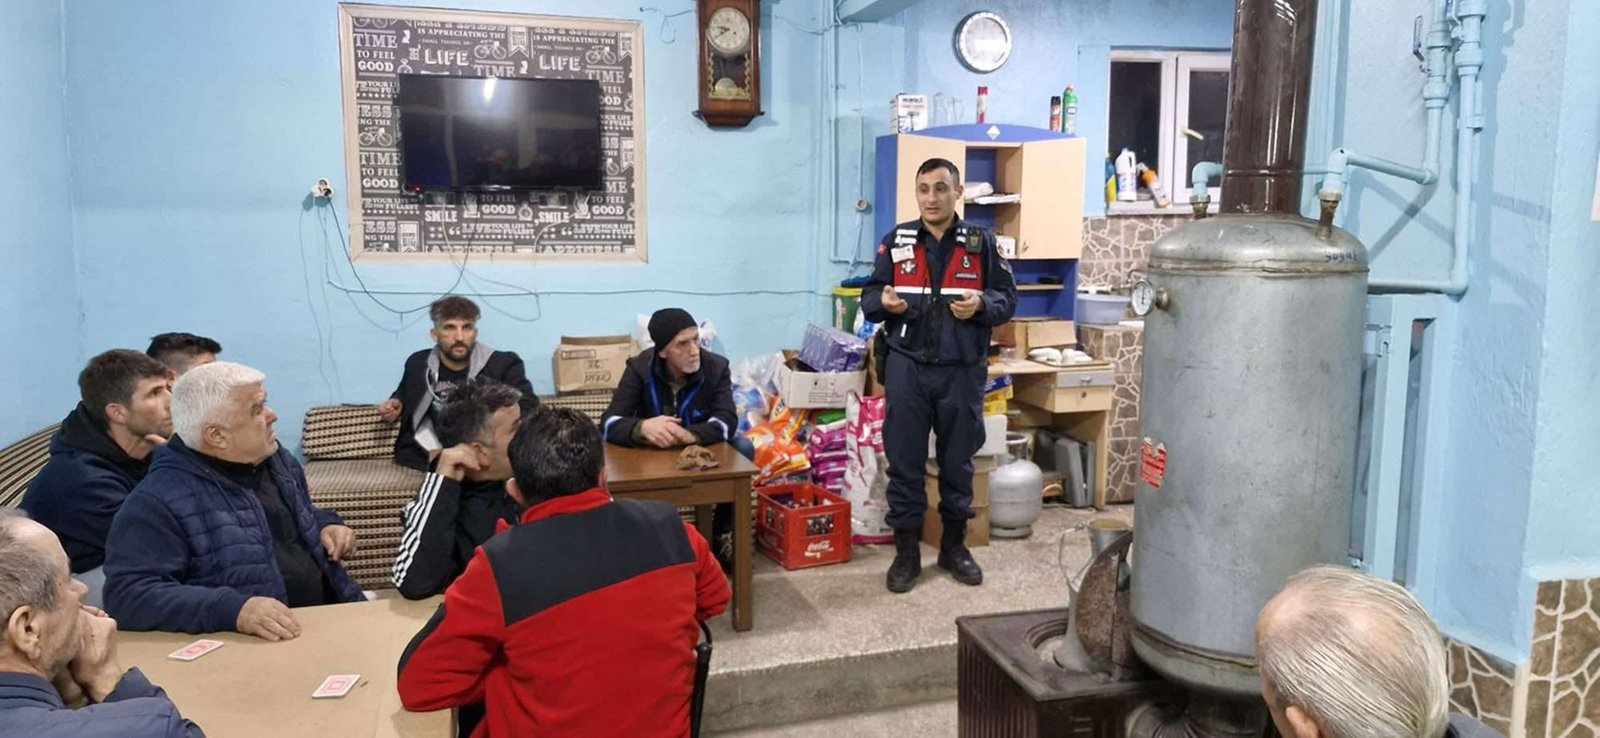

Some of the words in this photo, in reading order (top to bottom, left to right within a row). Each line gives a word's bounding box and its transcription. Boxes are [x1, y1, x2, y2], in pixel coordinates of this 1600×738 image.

[428, 28, 488, 38] APPRECIATING
[353, 33, 398, 48] TIME
[542, 35, 599, 44] APPRECIATING
[356, 50, 370, 58] TO
[373, 50, 396, 60] FEEL
[424, 48, 470, 66] LIFE
[358, 61, 394, 72] GOOD
[539, 54, 582, 72] LIFE
[474, 64, 516, 78] TIME
[584, 70, 625, 84] TIME
[359, 152, 401, 166] TIME
[362, 168, 374, 176] TO
[378, 168, 400, 177] FEEL
[362, 178, 398, 188] GOOD
[605, 181, 628, 194] ME
[482, 204, 516, 214] GOOD
[592, 206, 624, 215] GOOD
[424, 210, 458, 222] SMILE
[538, 212, 570, 222] SMILE
